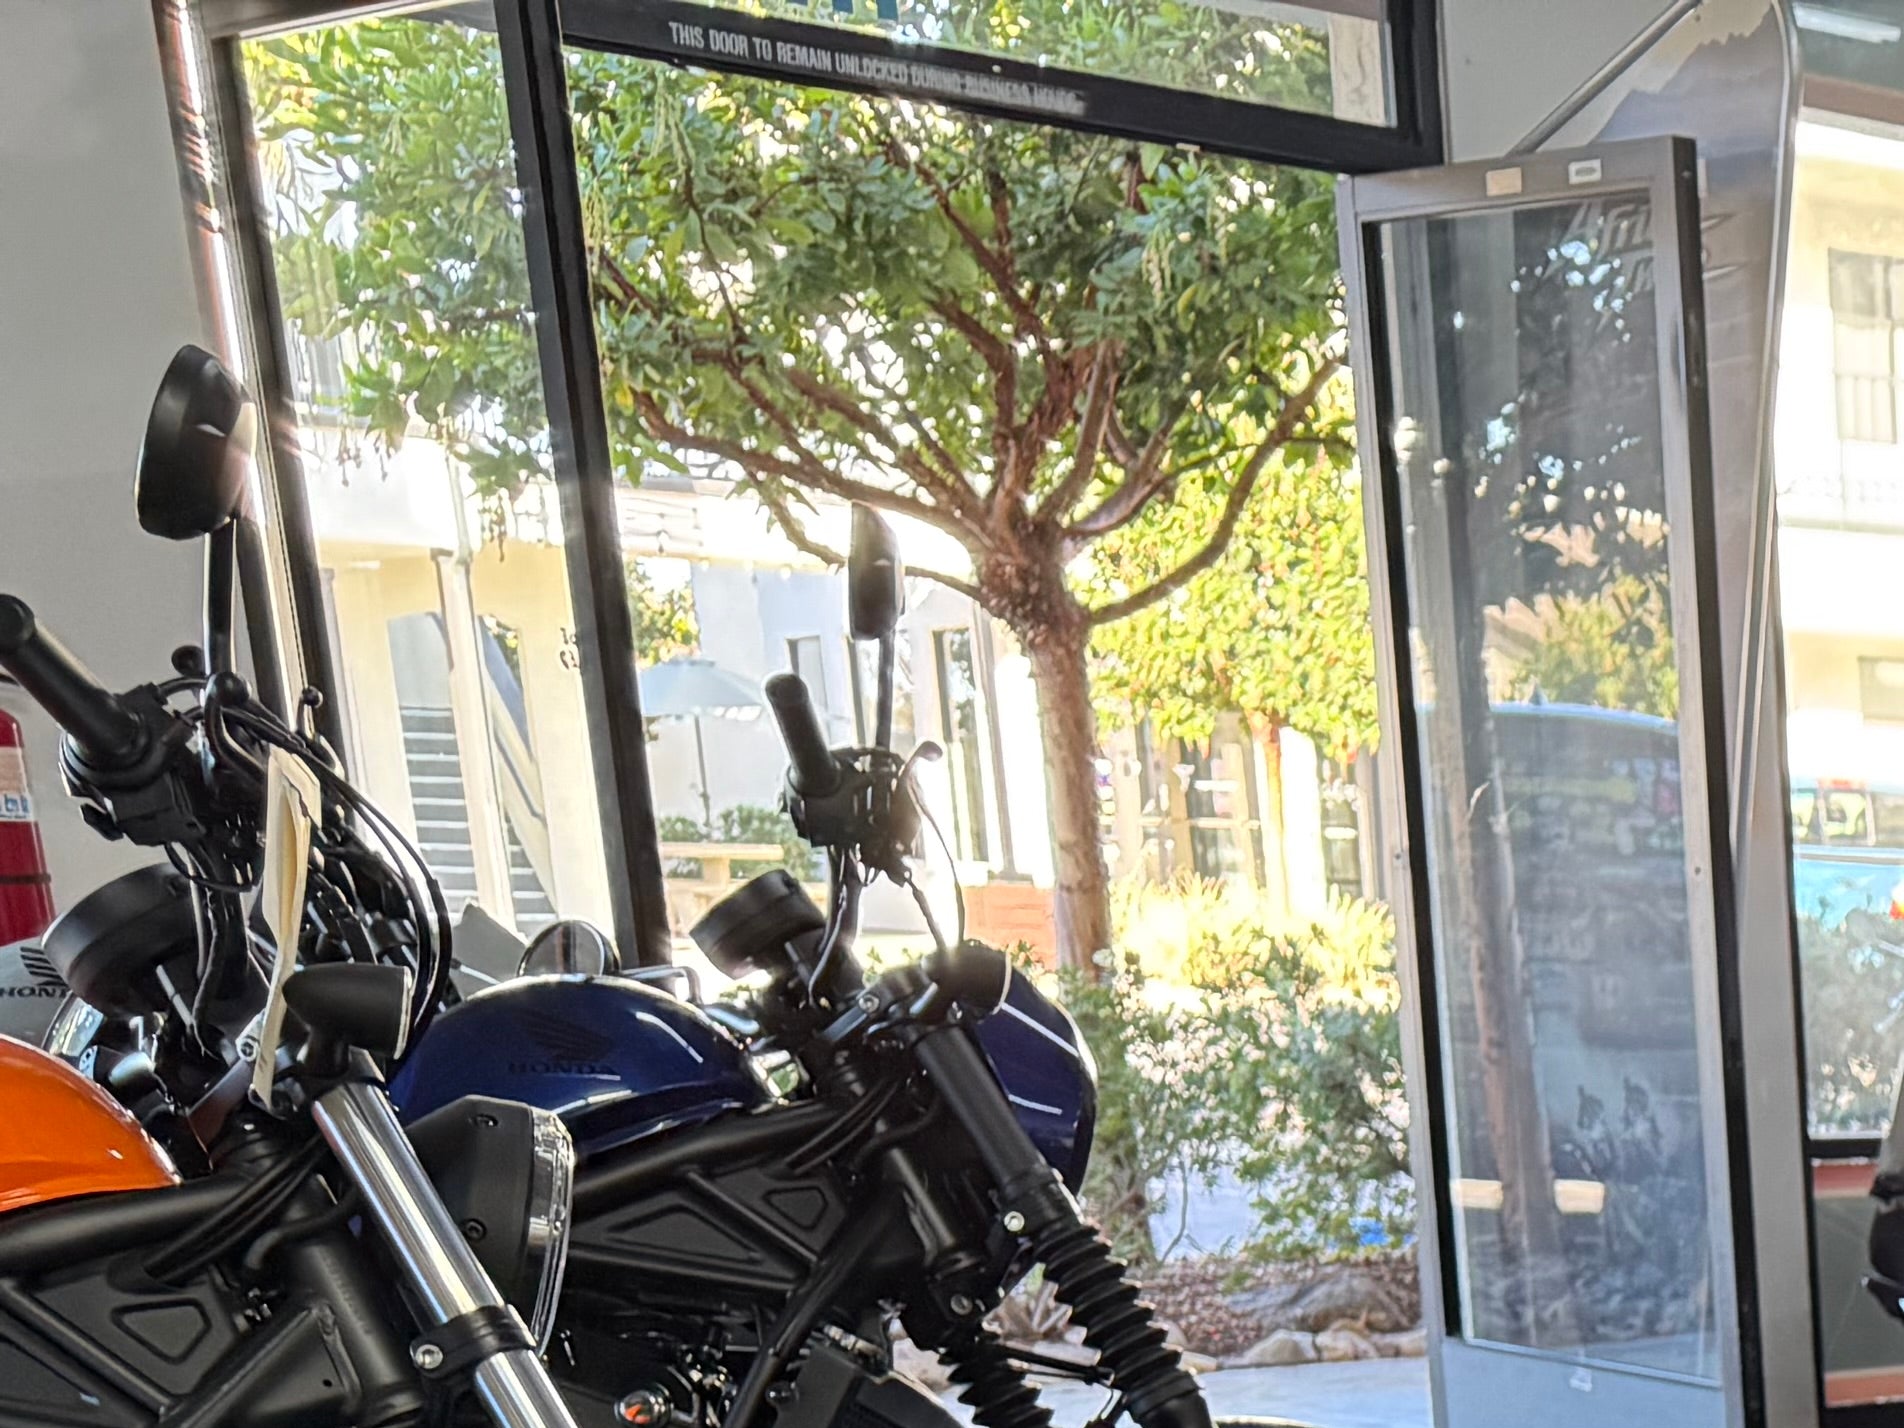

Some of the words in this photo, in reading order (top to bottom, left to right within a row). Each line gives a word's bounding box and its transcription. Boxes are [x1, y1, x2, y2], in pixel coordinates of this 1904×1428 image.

[669, 21, 704, 49] THIS
[709, 28, 748, 58] DOOR
[752, 36, 773, 62] TO
[776, 41, 833, 73] REMAIN
[834, 51, 910, 84] UNLOCKED
[0, 985, 69, 998] HON
